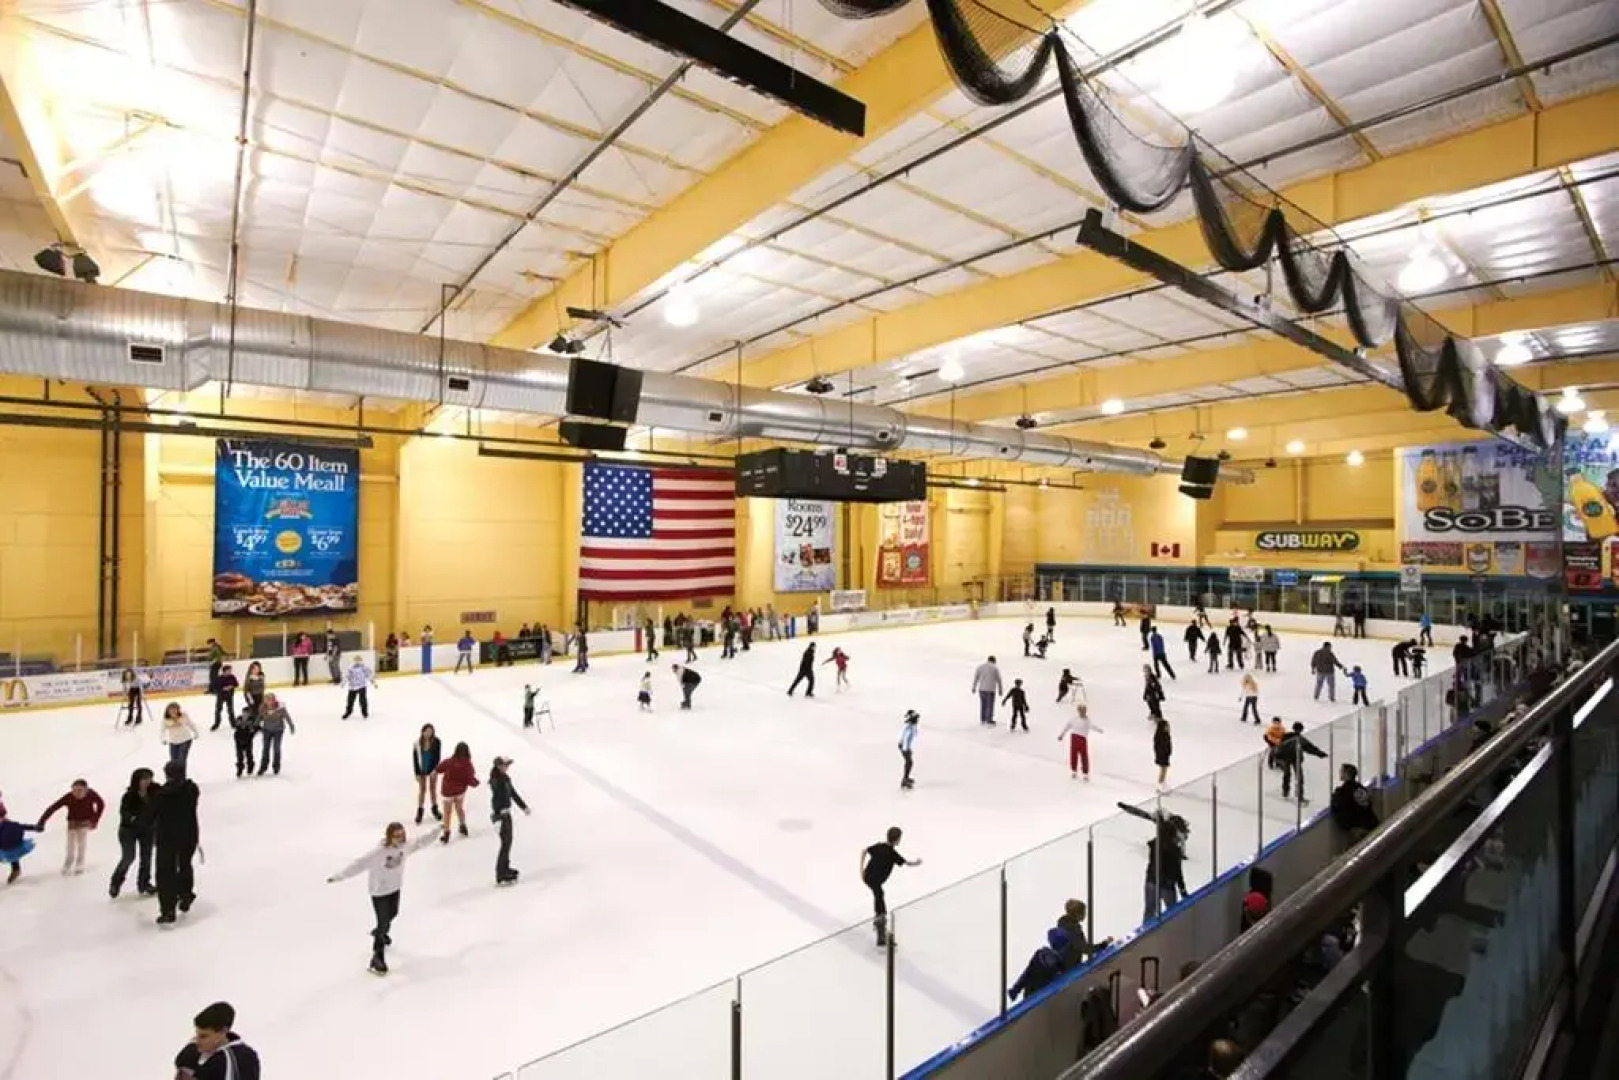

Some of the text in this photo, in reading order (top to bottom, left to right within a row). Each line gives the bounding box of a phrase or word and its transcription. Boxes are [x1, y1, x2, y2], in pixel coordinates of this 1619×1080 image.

[231, 450, 349, 473] The 60 Item
[235, 470, 346, 492] Value Meal!
[1259, 533, 1356, 548] SUBWAY
